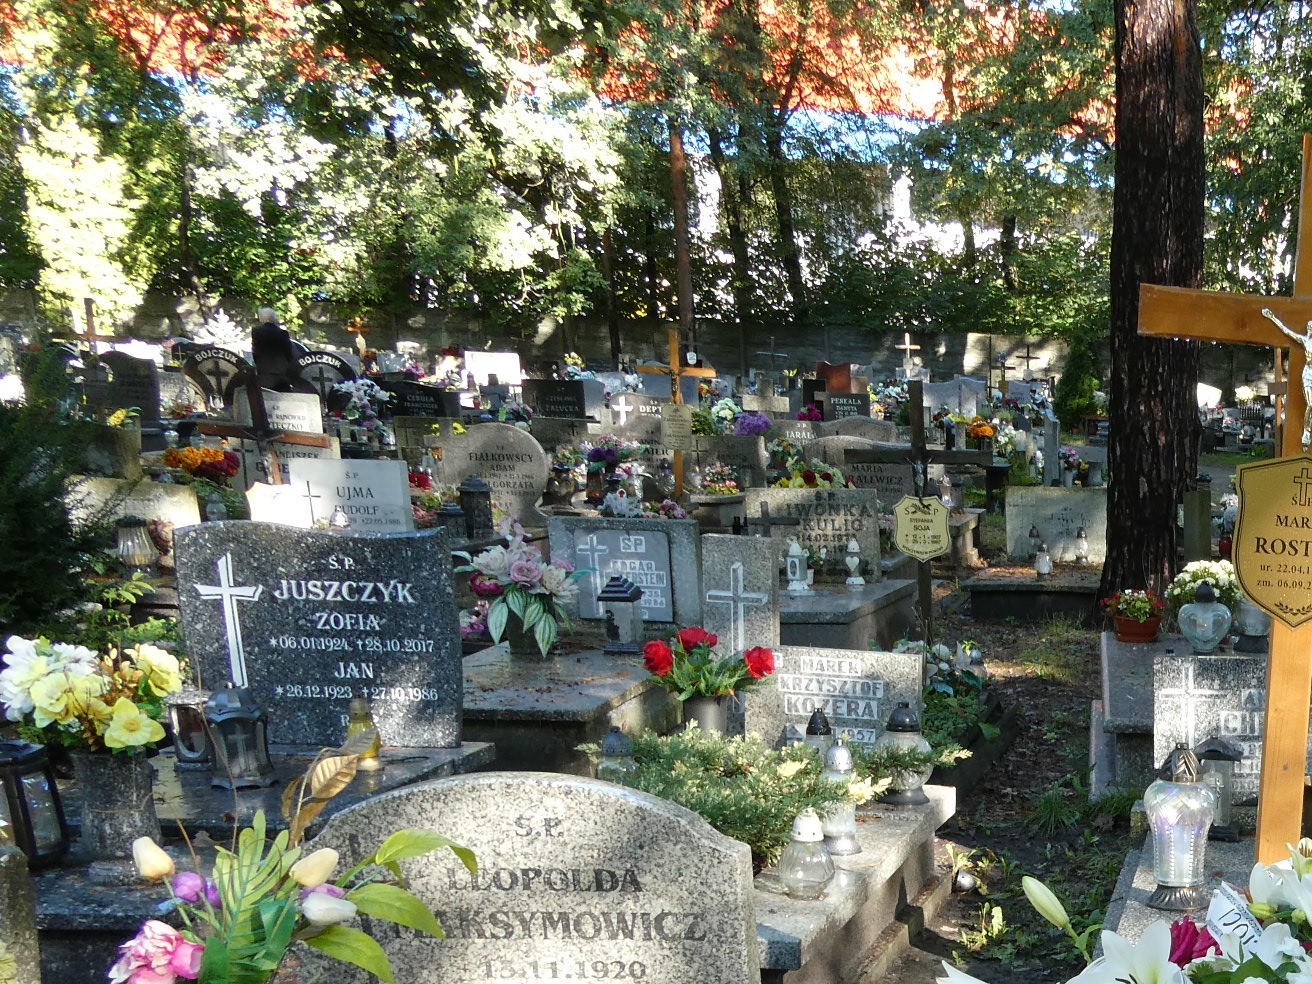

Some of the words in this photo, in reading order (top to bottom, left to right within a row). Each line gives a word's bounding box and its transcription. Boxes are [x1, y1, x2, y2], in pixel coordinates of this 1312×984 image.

[336, 486, 374, 501] UJMA
[273, 579, 416, 604] JUSZCZYK
[1257, 579, 1274, 587] zm.
[315, 612, 381, 631] ZOFIA
[366, 638, 435, 653] 28.10.2017
[334, 662, 375, 679] JAN
[801, 657, 860, 675] MAREK
[286, 684, 353, 699] 26.12.1923
[371, 686, 439, 702] 27.10.1986
[779, 675, 883, 698] KRZYSZTOF
[786, 696, 876, 719] KOZERA
[448, 866, 644, 893] LEOPOLDA
